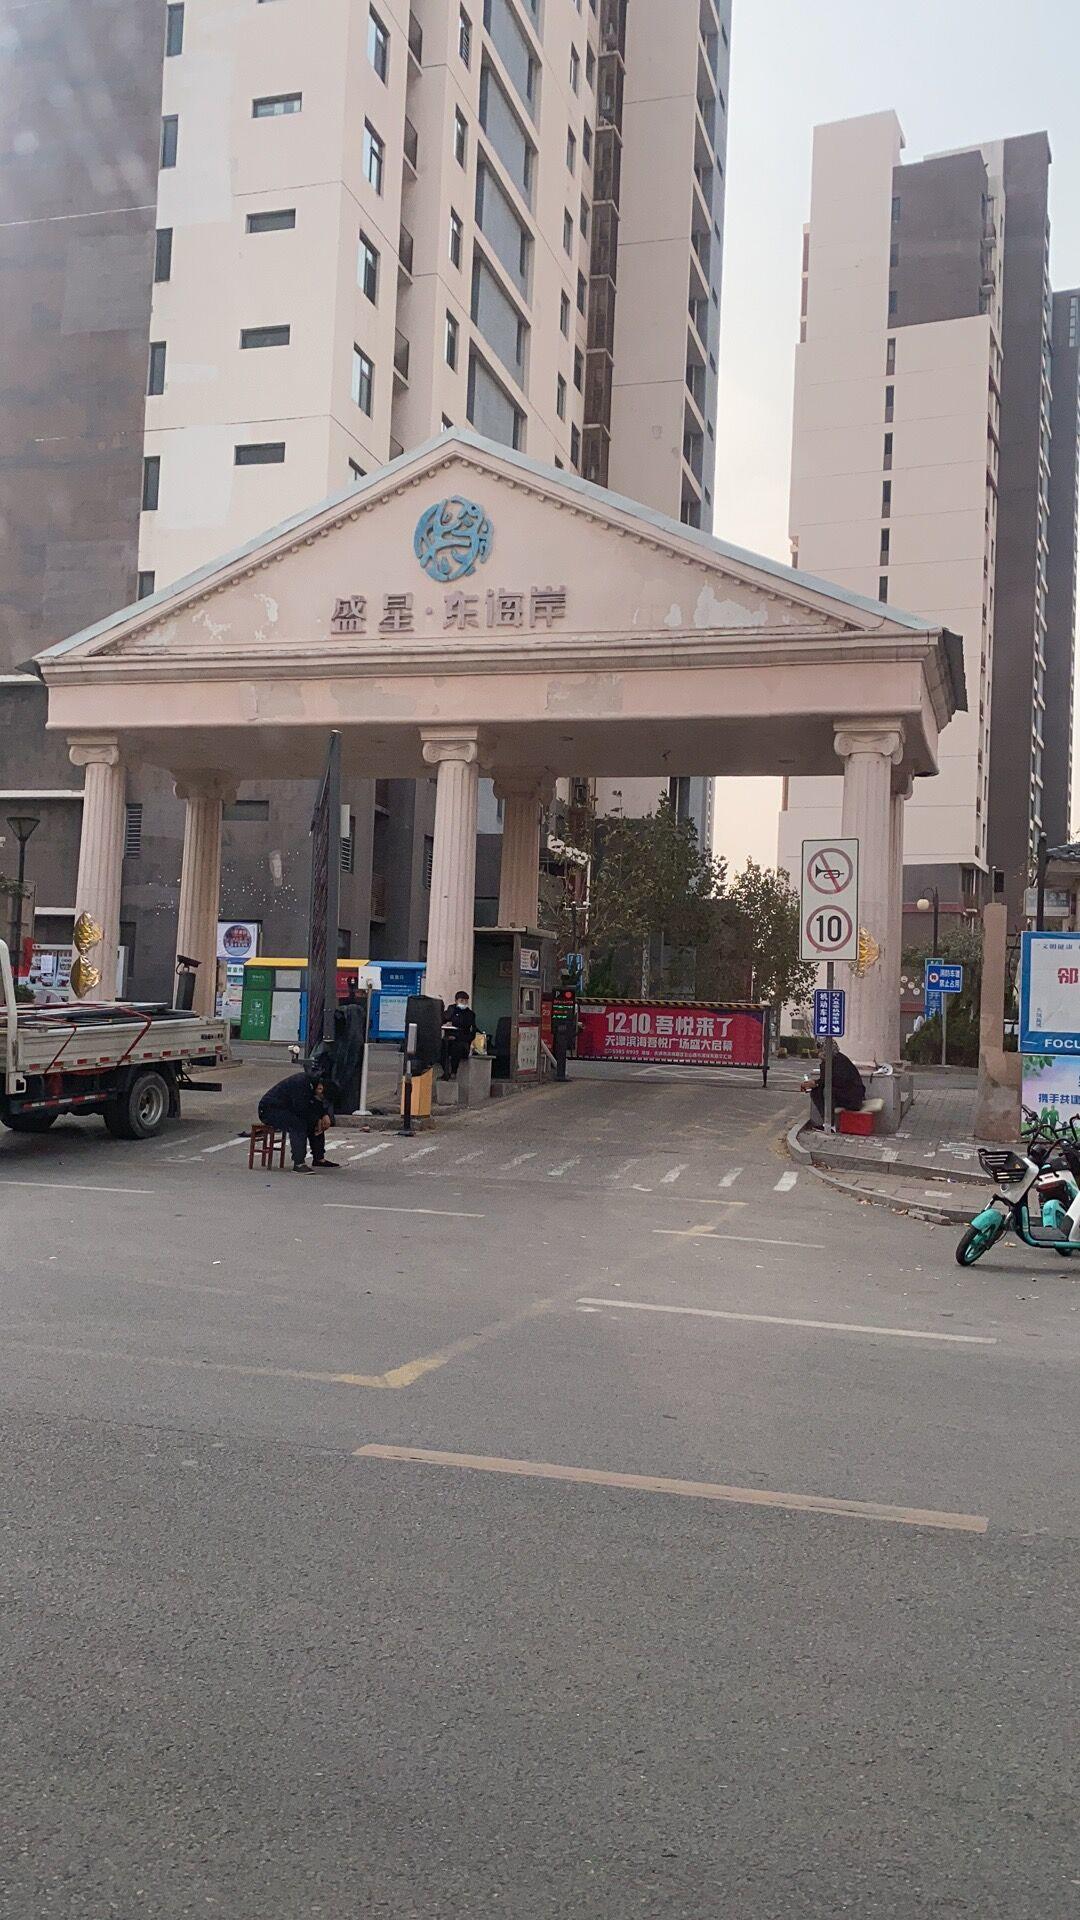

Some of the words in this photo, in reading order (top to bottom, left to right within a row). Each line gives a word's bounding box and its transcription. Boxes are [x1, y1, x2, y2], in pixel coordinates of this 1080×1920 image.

[816, 914, 842, 943] 10
[819, 992, 828, 1024] 机动车道
[655, 1015, 733, 1038] 吾悦来了
[605, 1035, 733, 1052] 天津滨海吾悦广场盛大启幕
